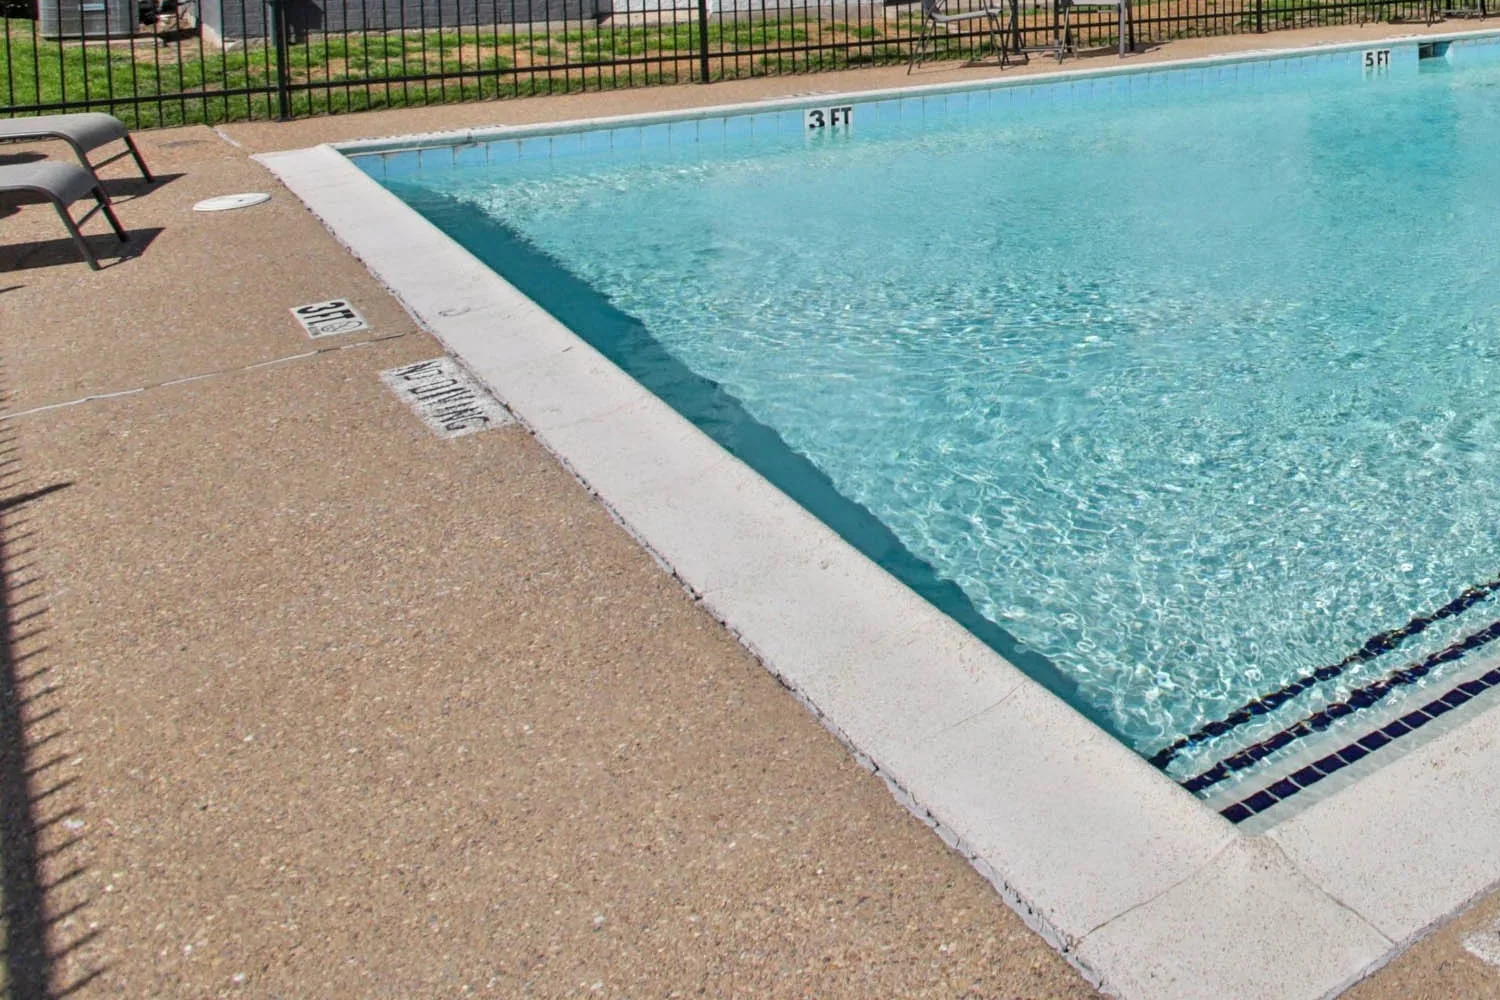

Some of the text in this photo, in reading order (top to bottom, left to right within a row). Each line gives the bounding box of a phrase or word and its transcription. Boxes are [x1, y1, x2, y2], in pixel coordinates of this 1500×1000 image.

[1366, 51, 1390, 67] 5 FT
[809, 107, 852, 128] 3 FT
[297, 301, 356, 324] 3 FT
[408, 378, 489, 432] DIVING
